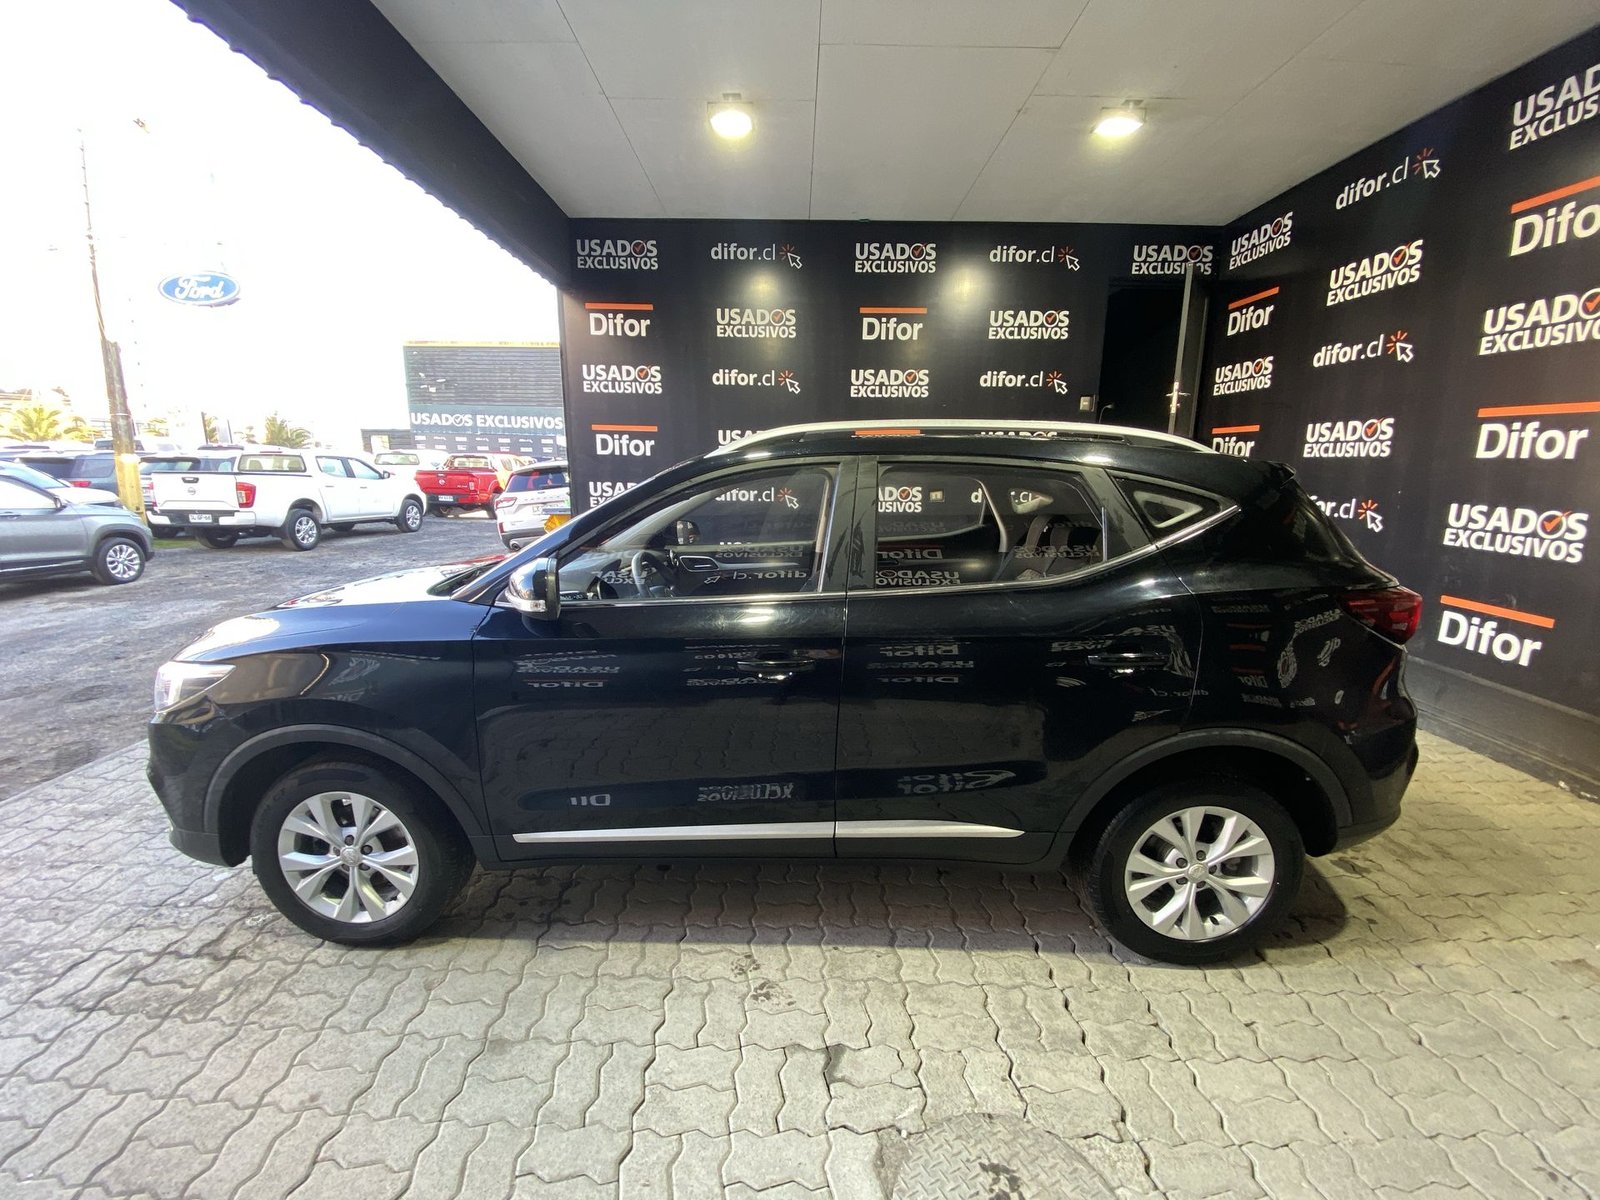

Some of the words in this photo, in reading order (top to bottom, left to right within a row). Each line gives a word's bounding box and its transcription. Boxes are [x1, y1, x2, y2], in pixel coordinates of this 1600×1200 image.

[1335, 156, 1409, 210] difor.cl
[1231, 211, 1293, 256] USADOS
[576, 239, 658, 257] USADOS
[711, 243, 776, 261] difor.cl
[855, 242, 936, 261] USADOS
[989, 245, 1055, 264] difor.cl
[1133, 245, 1214, 262] USADOS
[1229, 231, 1291, 270] EXCLUSIVOS
[577, 256, 659, 270] EXCLUSIVOS
[855, 260, 936, 273] EXCLUSIVOS
[1329, 239, 1424, 289] USADOS
[174, 275, 225, 300] Ford
[1326, 264, 1420, 307] EXCLUSIVOS
[589, 313, 651, 337] Difor
[716, 308, 796, 326] USADOS
[989, 310, 1070, 328] USADOS
[1227, 304, 1274, 336] Difor
[716, 325, 796, 338] EXCLUSIVOS
[862, 317, 923, 341] Difor
[988, 327, 1069, 340] EXCLUSIVOS
[1313, 334, 1384, 368] difor.cl
[582, 364, 662, 382] USADOS
[712, 369, 775, 387] difor.cl
[850, 369, 929, 386] USADOS
[1215, 356, 1274, 383] USADOS
[583, 381, 662, 395] EXCLUSIVOS
[979, 371, 1043, 388] difor.cl
[1213, 375, 1272, 396] EXCLUSIVOS
[850, 385, 929, 398] EXCLUSIVOS
[411, 412, 473, 427] USADOS
[476, 414, 563, 430] EXCLUSIVOS
[1306, 418, 1394, 443] USADOS
[595, 433, 655, 457] Difor
[1303, 440, 1391, 458] EXCLUSIVOS
[1475, 422, 1589, 460] Difor
[1448, 502, 1589, 541] USADOS
[1443, 527, 1584, 563] EXCLUSIVOS
[1437, 610, 1543, 667] Difor
